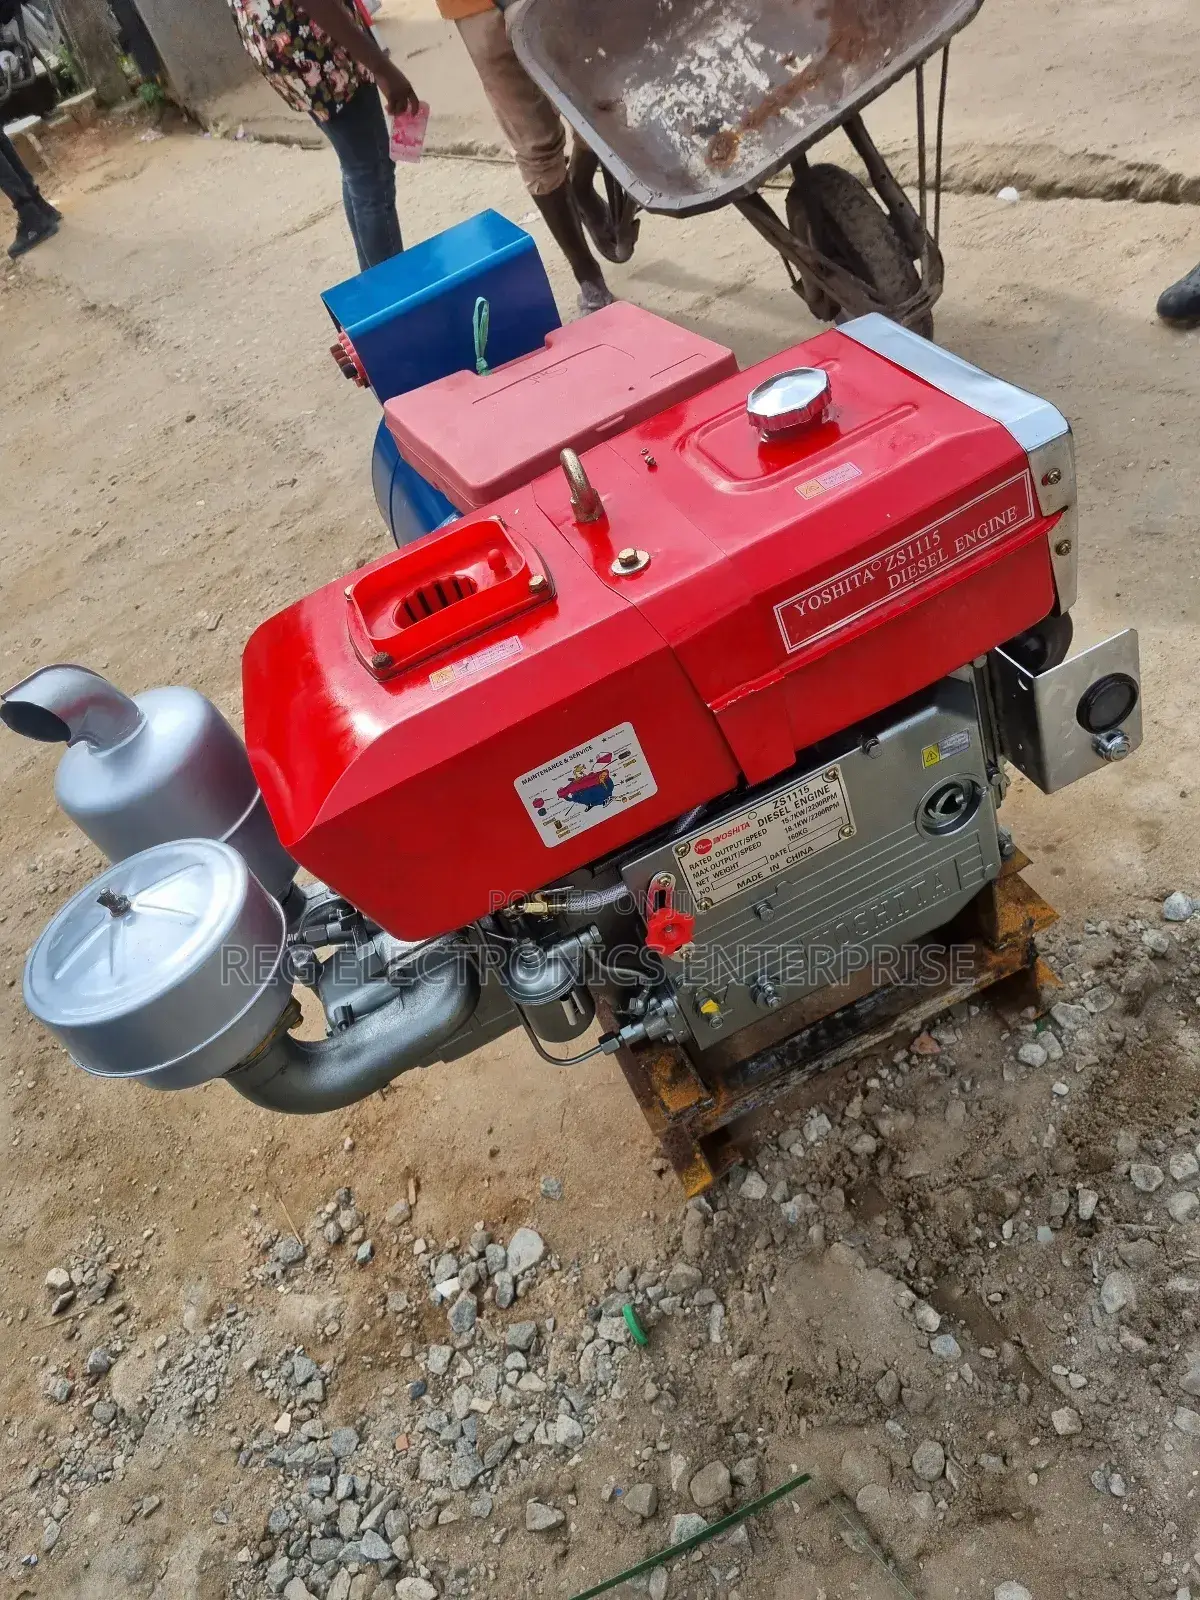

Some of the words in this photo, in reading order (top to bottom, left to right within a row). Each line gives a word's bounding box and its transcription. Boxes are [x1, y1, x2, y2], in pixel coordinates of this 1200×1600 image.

[887, 550, 949, 591] DIESEL
[953, 505, 1018, 554] ENGINE
[793, 571, 875, 617] YOSHITA
[884, 529, 941, 572] ZS1115
[521, 761, 563, 785] MAINTENANCE
[568, 745, 593, 762] SERVICE
[757, 807, 792, 828] DIESEL
[794, 784, 831, 809] ENGINE
[773, 785, 810, 810] ZS1115
[688, 855, 713, 871] RATED
[714, 828, 769, 857] OUTPUT/SPEED
[692, 841, 762, 880] MAX.OUTPUT/SPEED
[736, 871, 764, 890] MADE
[769, 863, 780, 873] IN
[785, 845, 814, 864] CHINA
[769, 847, 787, 861] DATE
[696, 877, 710, 888] NET
[712, 861, 741, 879] WEIGHT
